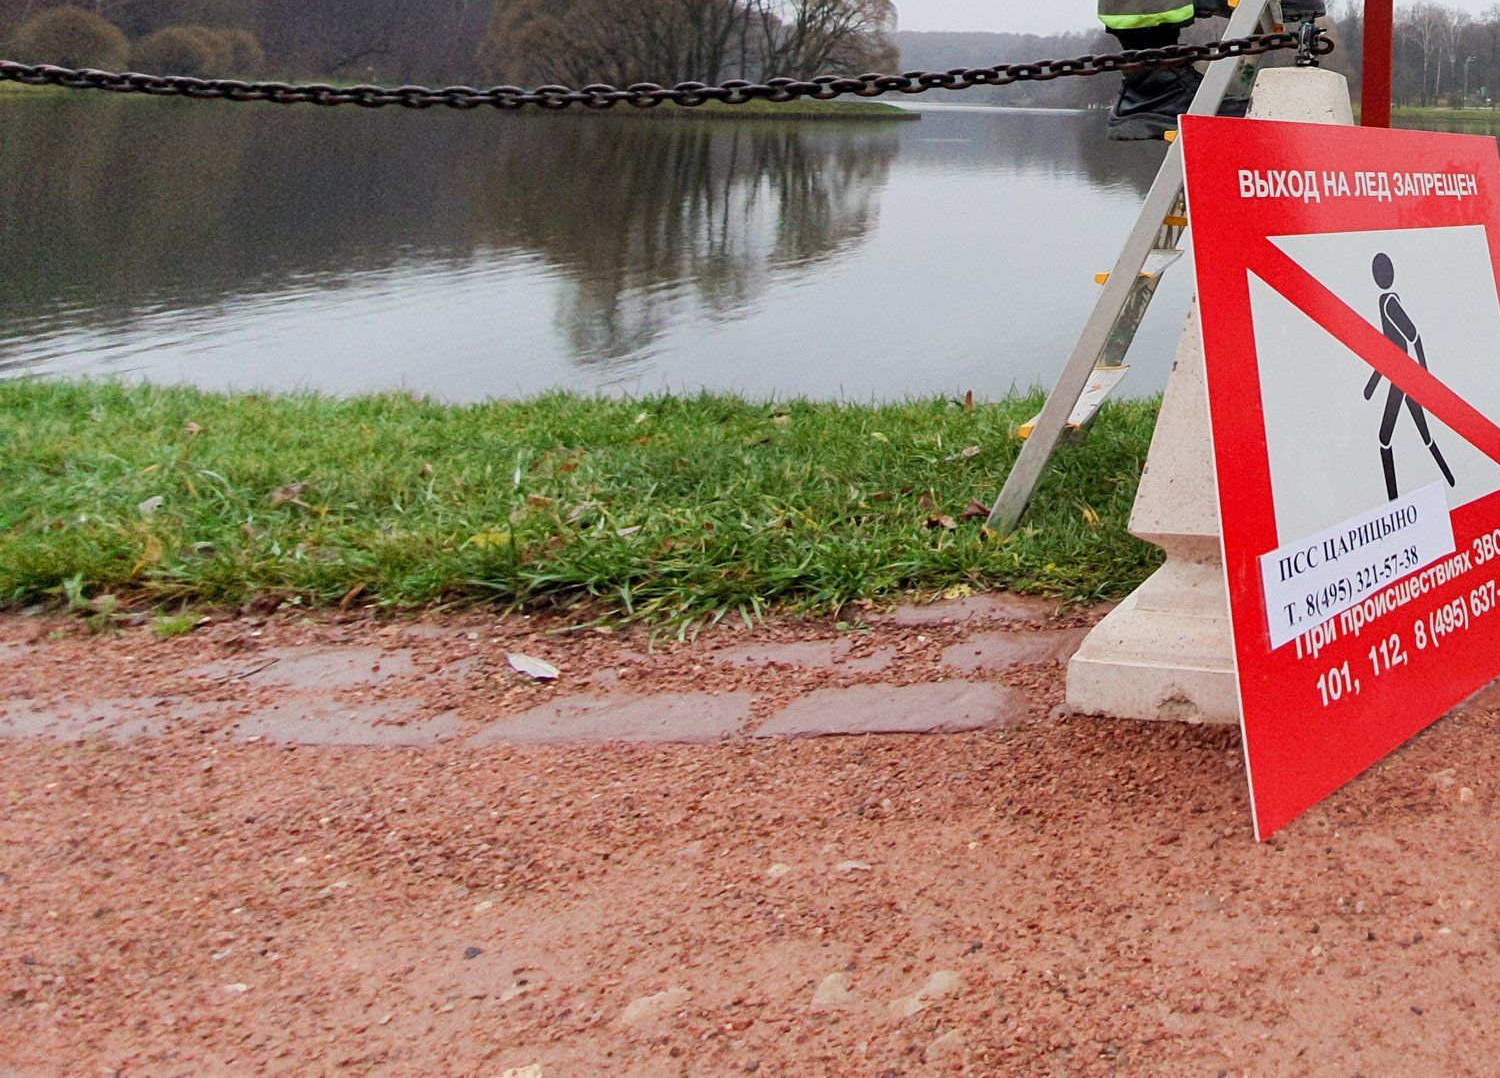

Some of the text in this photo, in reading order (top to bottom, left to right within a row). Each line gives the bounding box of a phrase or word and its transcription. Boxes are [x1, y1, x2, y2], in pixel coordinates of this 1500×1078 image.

[1238, 169, 1478, 204] ВЫХОД НА ЛЕД ЗАПРЕЩЕН
[1279, 504, 1418, 582] ПСС ЦАРИЦЫНО
[1305, 578, 1353, 617] 8(495)
[1356, 545, 1419, 593] 321-57-38
[1295, 617, 1337, 659] При
[1340, 550, 1472, 637] происшествиях
[1316, 660, 1360, 707] 101,
[1368, 633, 1408, 676] 112,
[1414, 619, 1427, 650] 8
[1429, 595, 1469, 648] (495)
